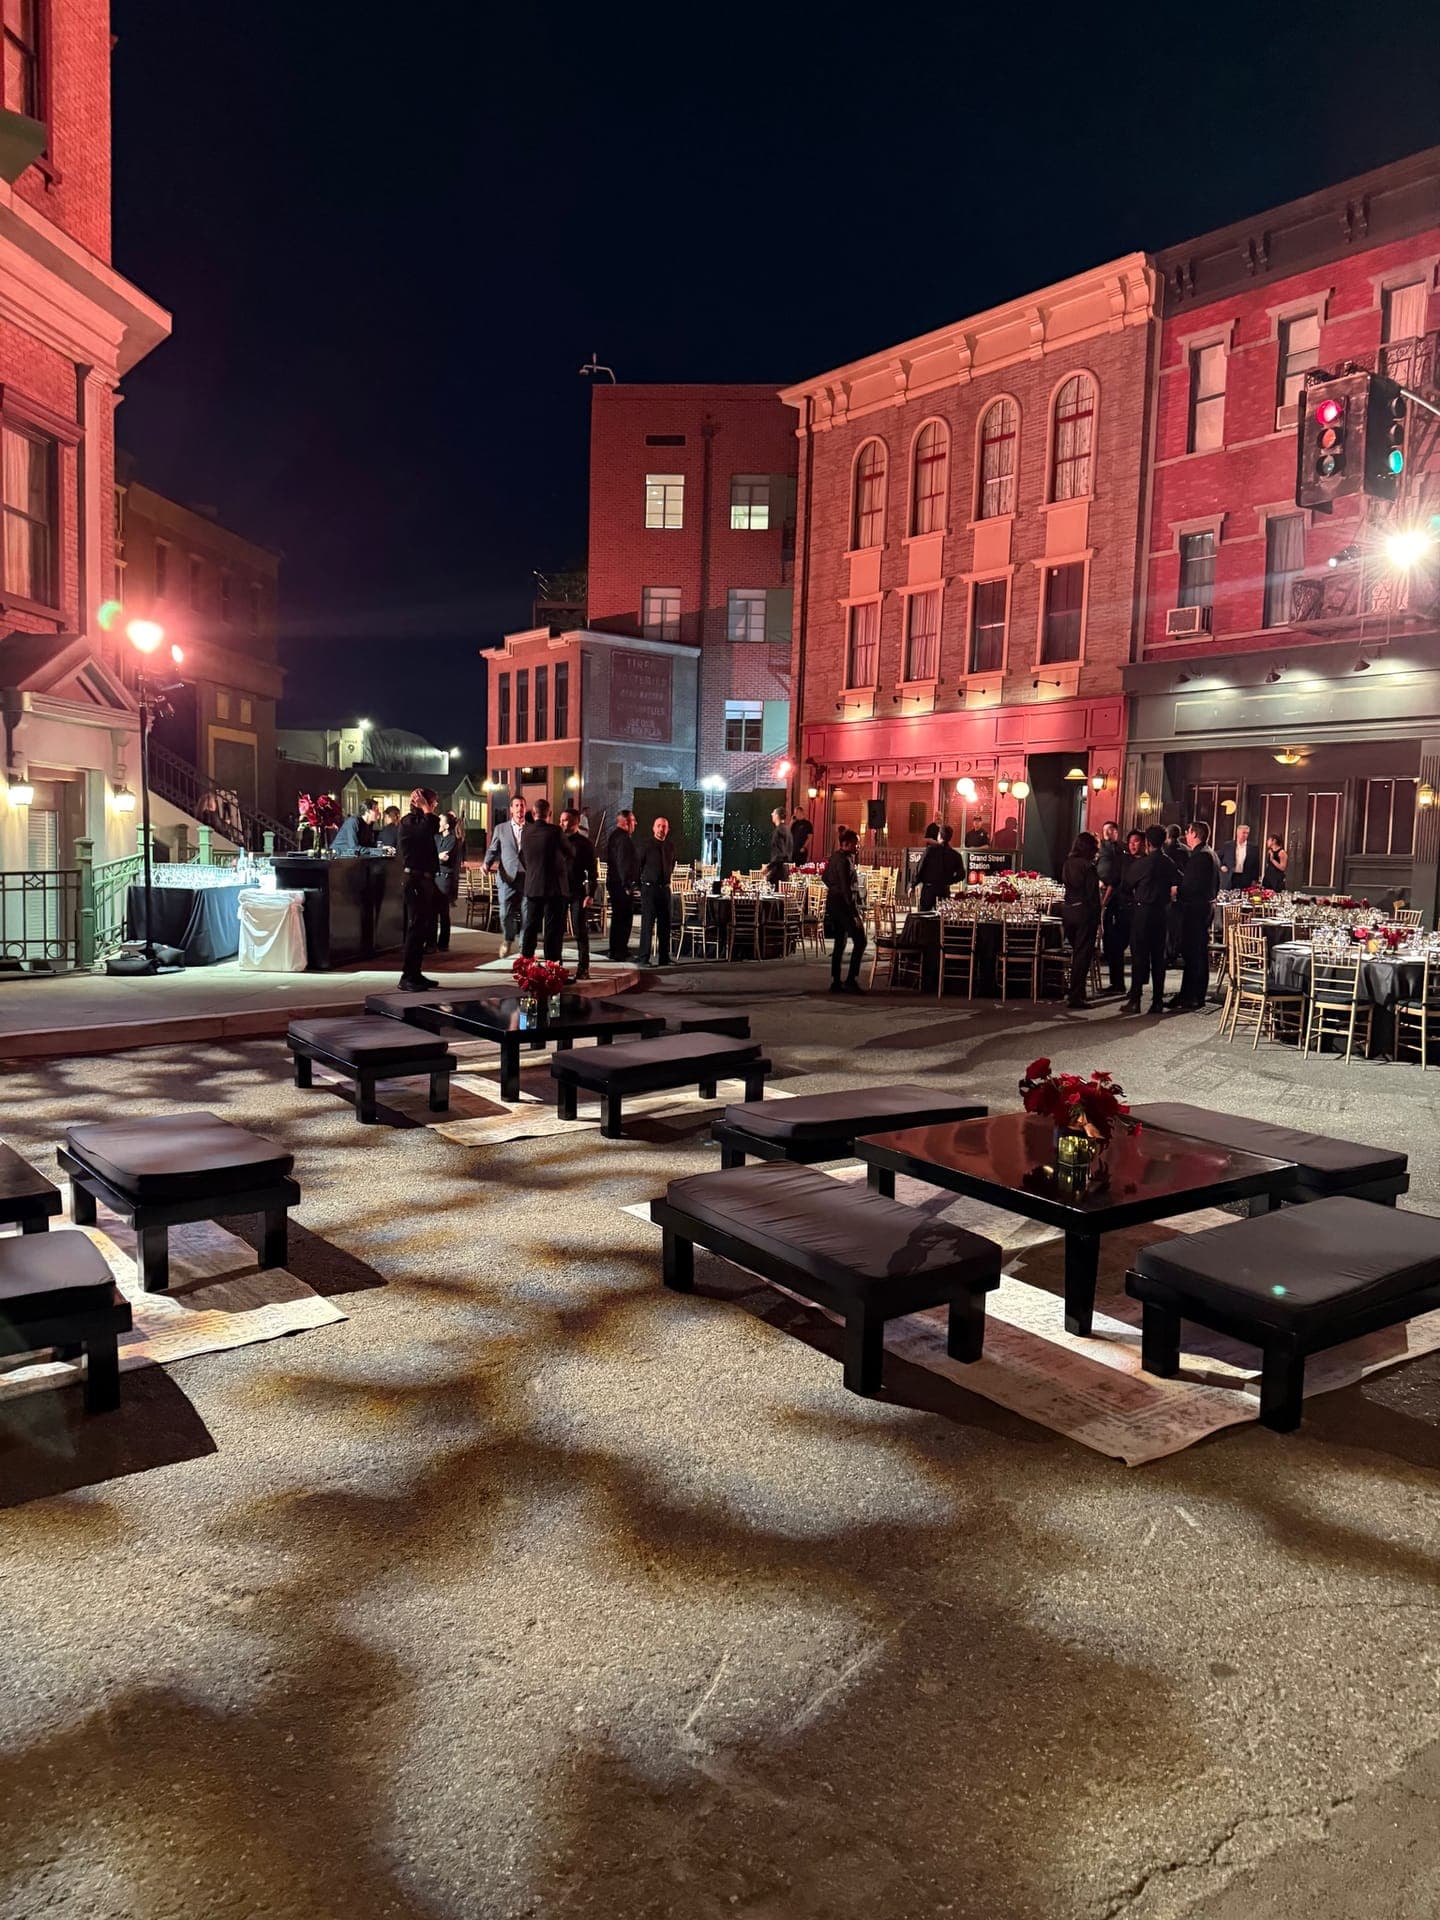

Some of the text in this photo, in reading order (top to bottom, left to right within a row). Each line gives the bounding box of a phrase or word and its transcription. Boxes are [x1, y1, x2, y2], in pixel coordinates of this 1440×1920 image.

[348, 744, 355, 753] 9
[969, 854, 1005, 862] Grand Street
